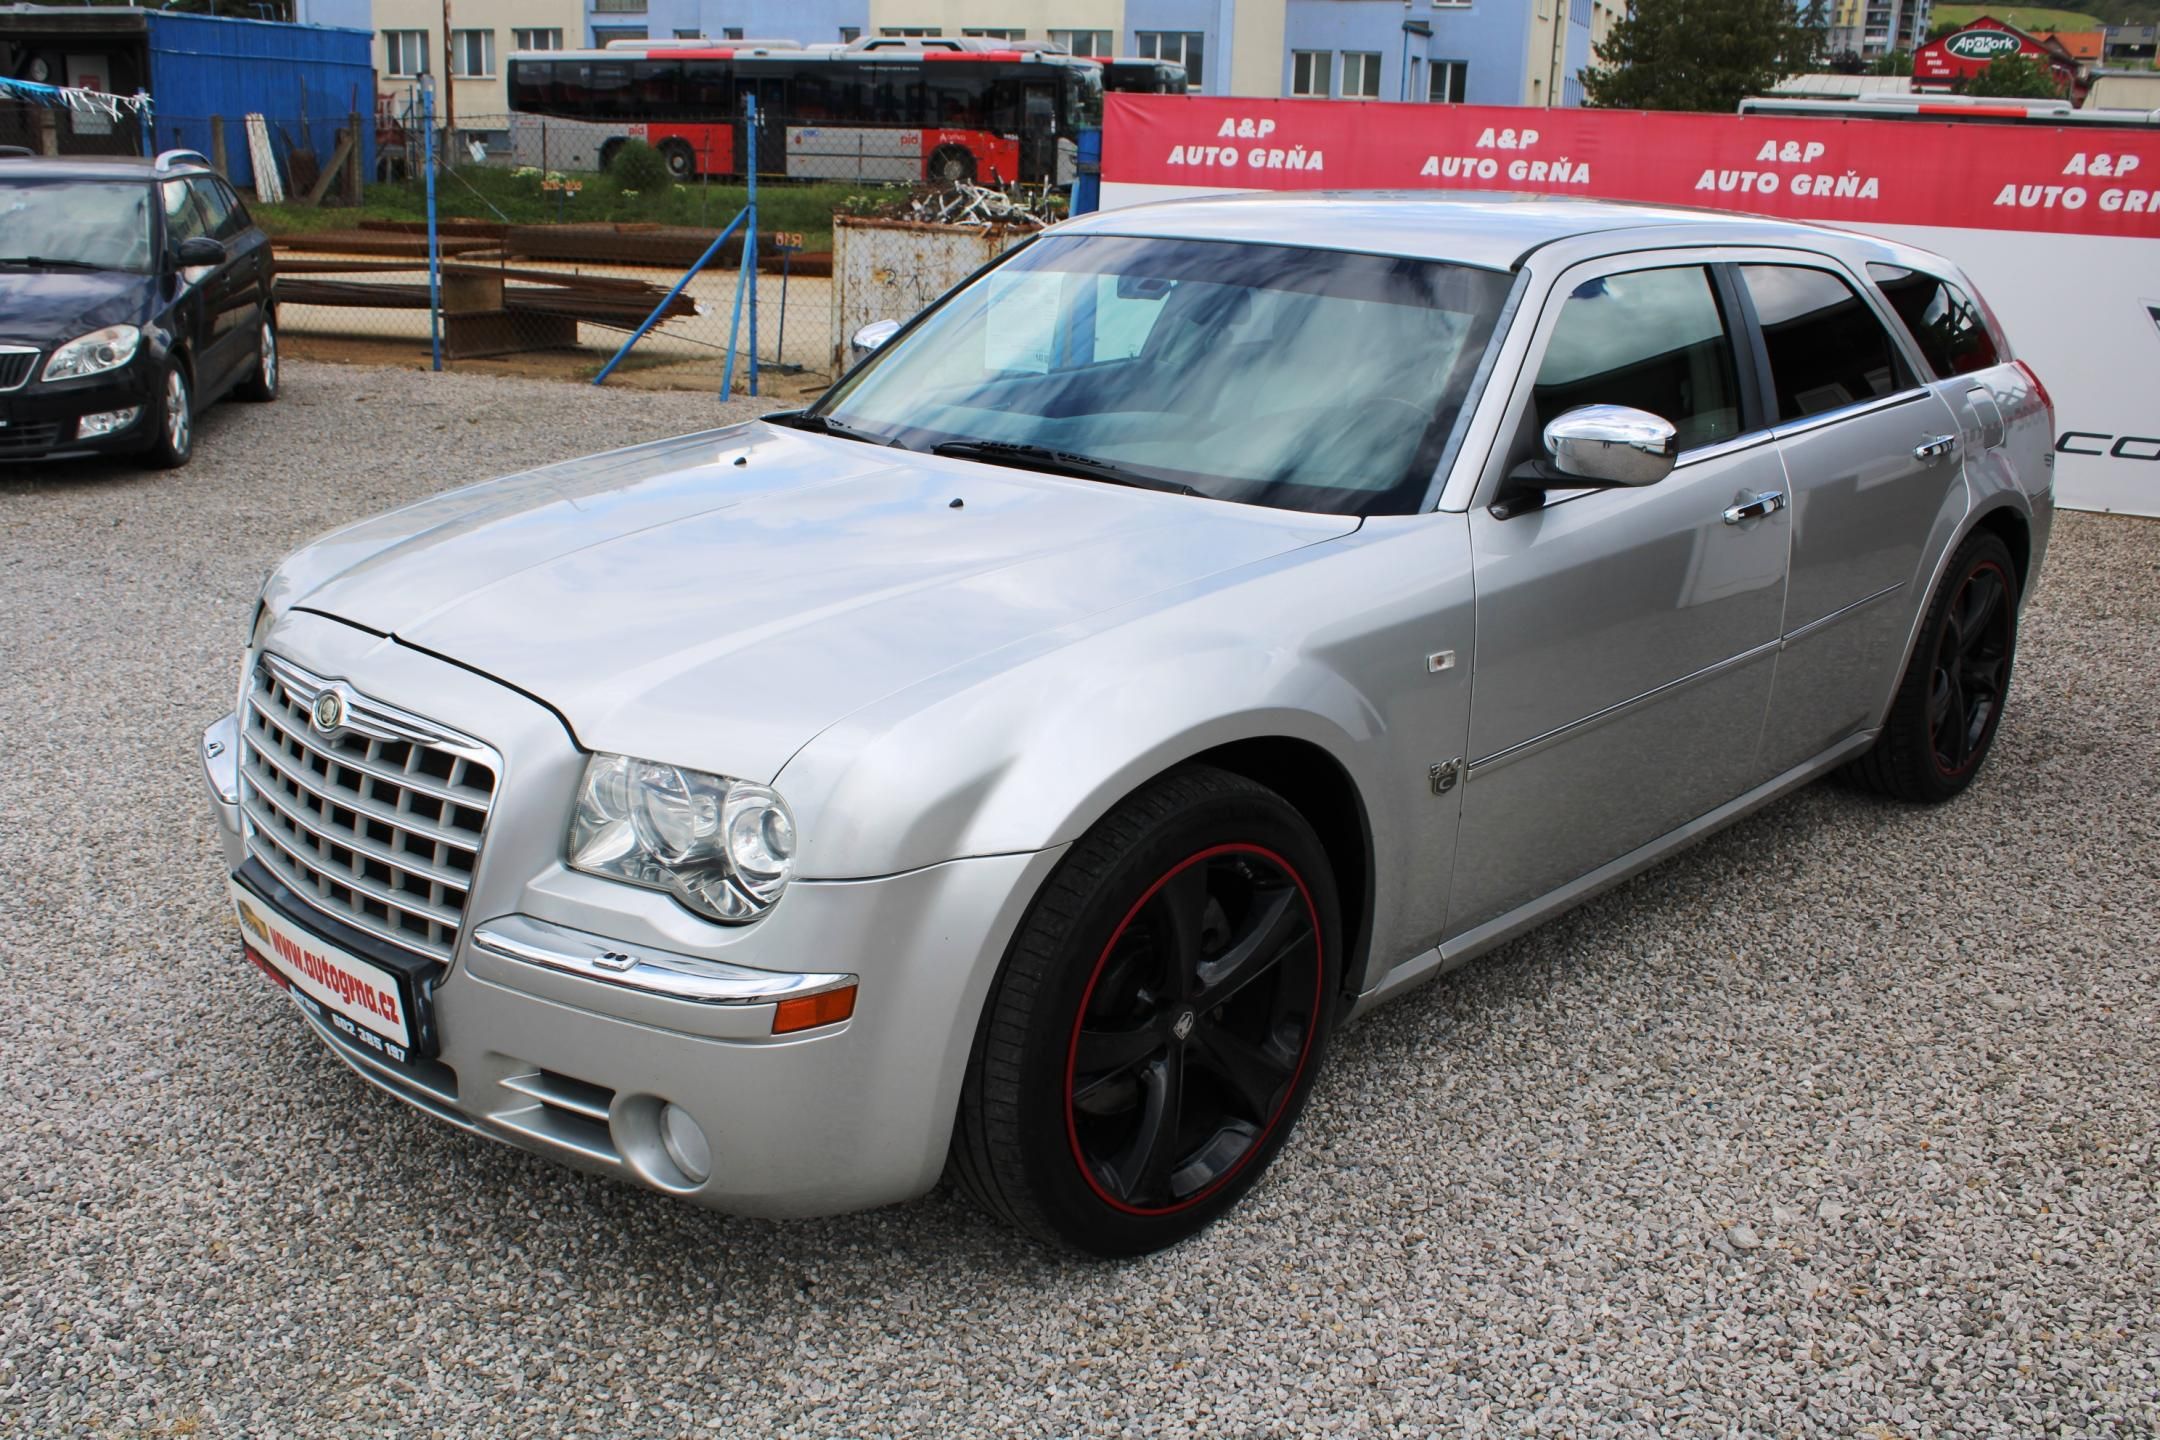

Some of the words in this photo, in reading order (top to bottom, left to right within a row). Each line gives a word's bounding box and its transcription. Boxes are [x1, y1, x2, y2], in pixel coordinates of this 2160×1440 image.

[1217, 118, 1276, 139] A&P
[1475, 128, 1539, 150] A&P
[1167, 146, 1239, 167] AUTO
[1247, 145, 1323, 171] GRŇA
[1756, 140, 1825, 163] A&P
[1420, 155, 1499, 179] AUTO
[1508, 157, 1590, 184] GRŇA
[2062, 153, 2140, 177] A&P
[1695, 169, 1780, 194] AUTO
[1790, 170, 1879, 199] GRŇA
[1994, 184, 2087, 210] AUTO
[269, 926, 399, 1024] www.autogrna.cz
